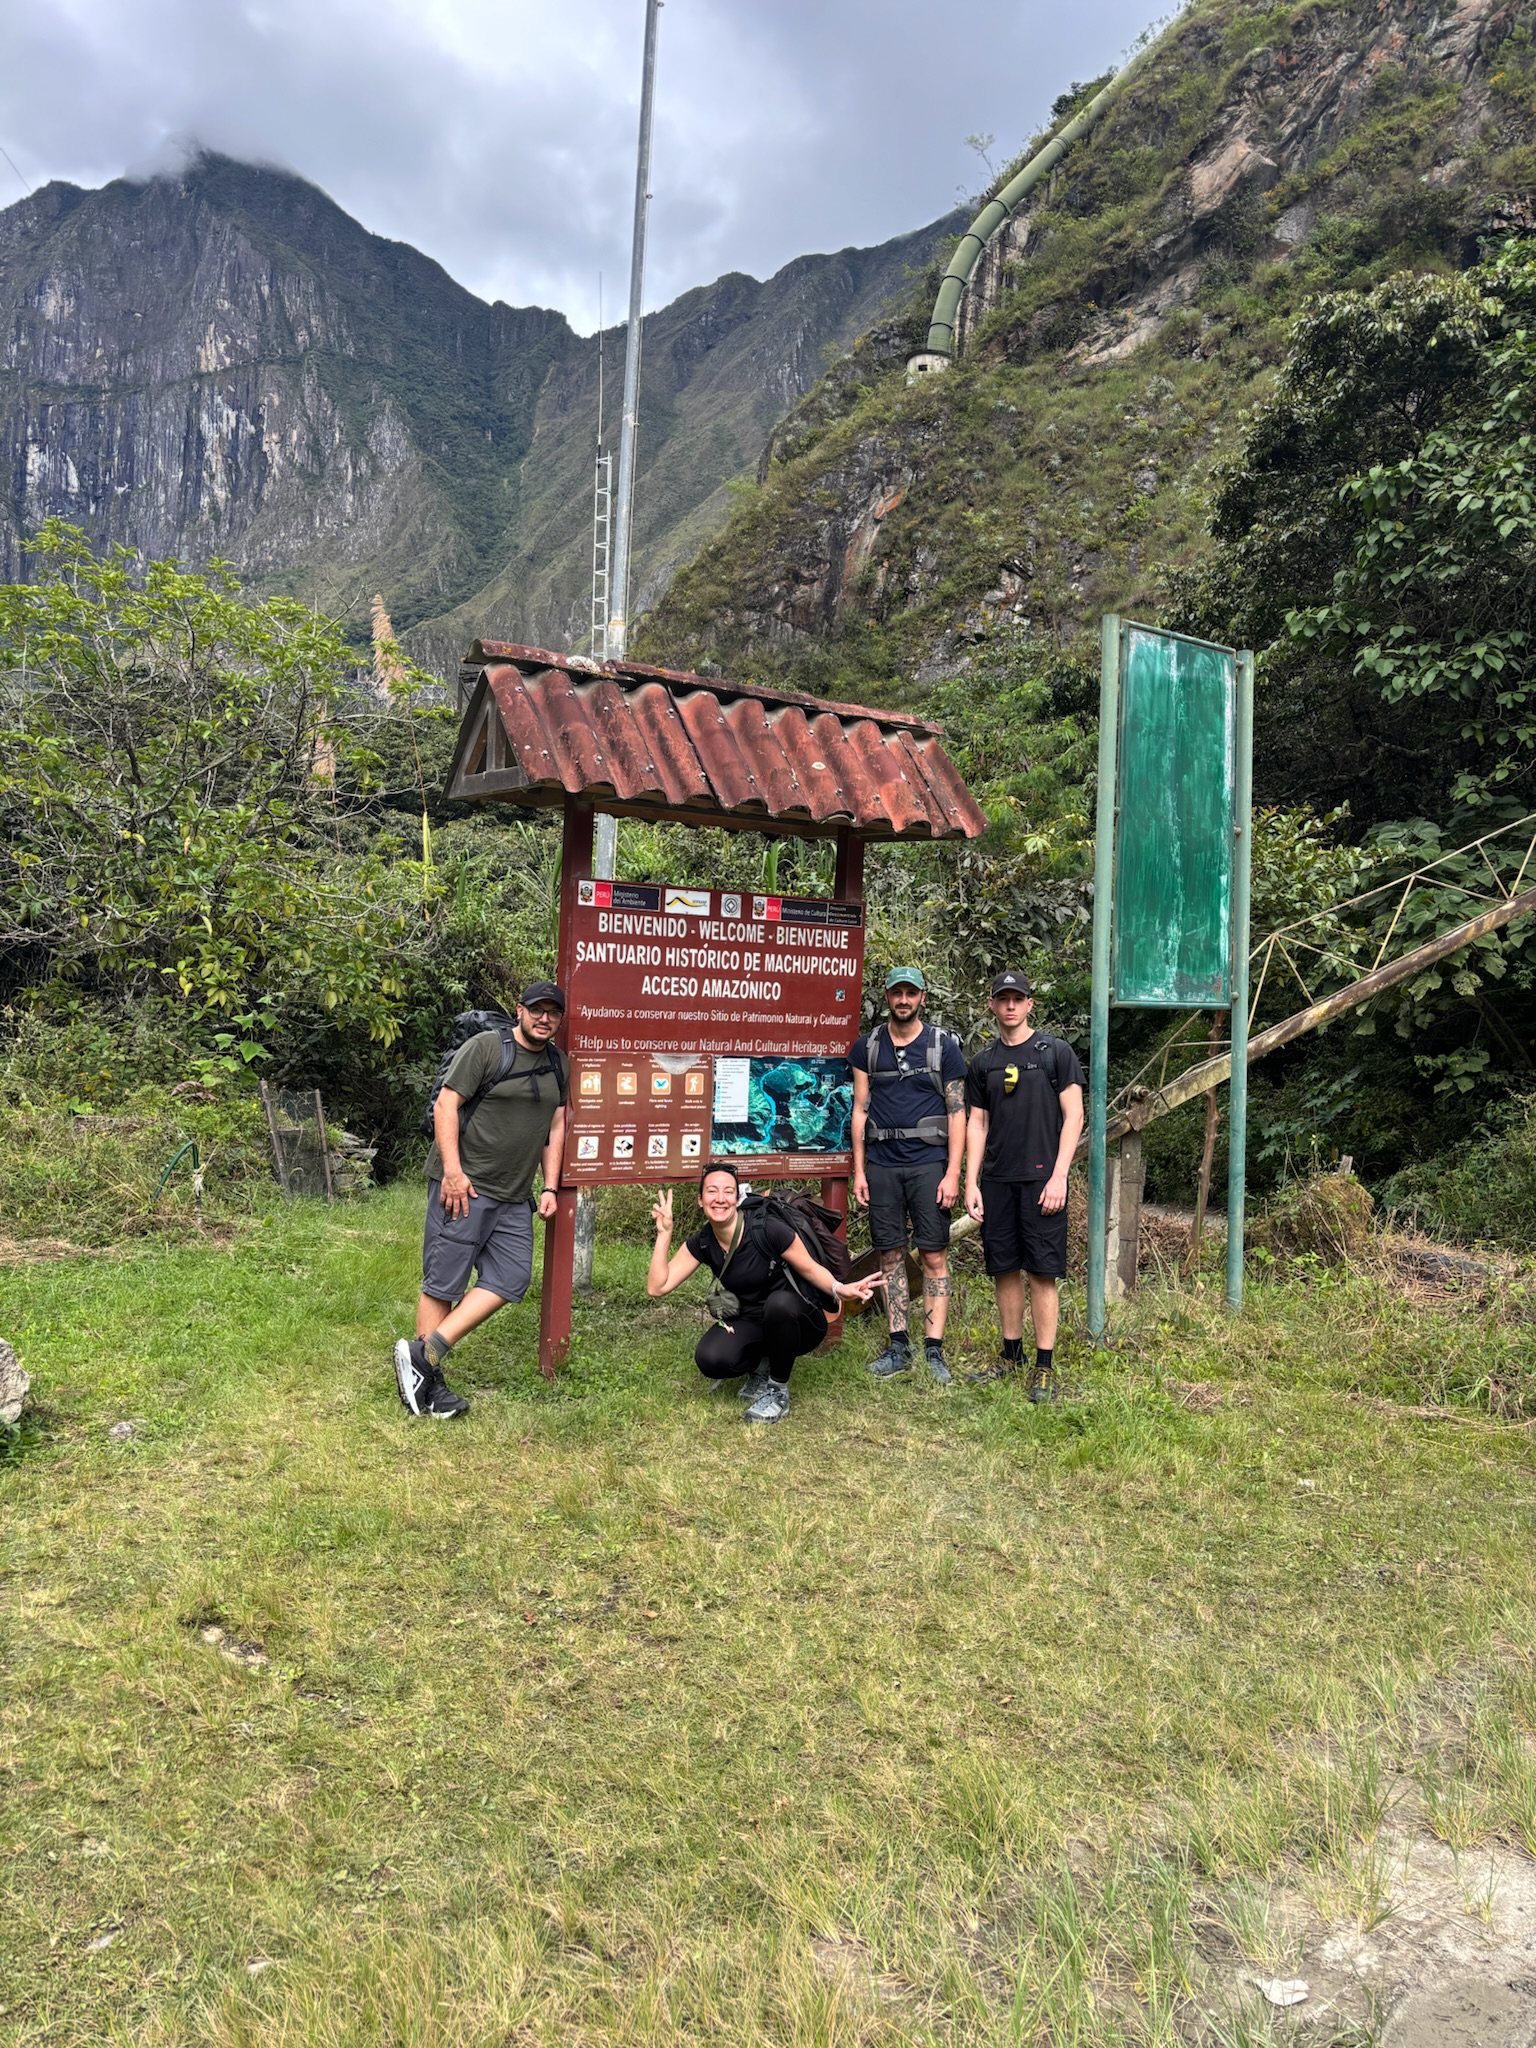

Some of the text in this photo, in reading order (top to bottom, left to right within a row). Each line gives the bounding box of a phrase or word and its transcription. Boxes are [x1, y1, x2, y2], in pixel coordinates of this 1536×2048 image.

[613, 889, 640, 899] Ministerio
[622, 898, 647, 907] Ambiente
[782, 906, 827, 917] Ministerio de Cultura
[598, 911, 687, 938] BIENVENIDO
[699, 919, 765, 944] WELCOME
[776, 925, 849, 949] BIENVENUE
[576, 940, 857, 977] SANTUARIO HISTÓRICO DE MACHUPICCHU
[641, 973, 781, 1000] ACCESO AMAZÓNICO
[627, 1009, 632, 1018] a
[634, 1009, 676, 1020] conservar
[678, 1010, 709, 1021] nuestro
[710, 1009, 729, 1021] Sitio
[730, 1011, 741, 1021] de
[742, 1010, 784, 1024] Patrimonio
[785, 1012, 812, 1025] Natural
[812, 1016, 819, 1027] y
[606, 1038, 619, 1049] us
[621, 1037, 632, 1050] to
[634, 1039, 679, 1051] conserve
[680, 1040, 697, 1051] our
[699, 1038, 733, 1051] Natural
[734, 1038, 753, 1052] And
[755, 1039, 790, 1053] Cultural
[791, 1040, 828, 1057] Heritage
